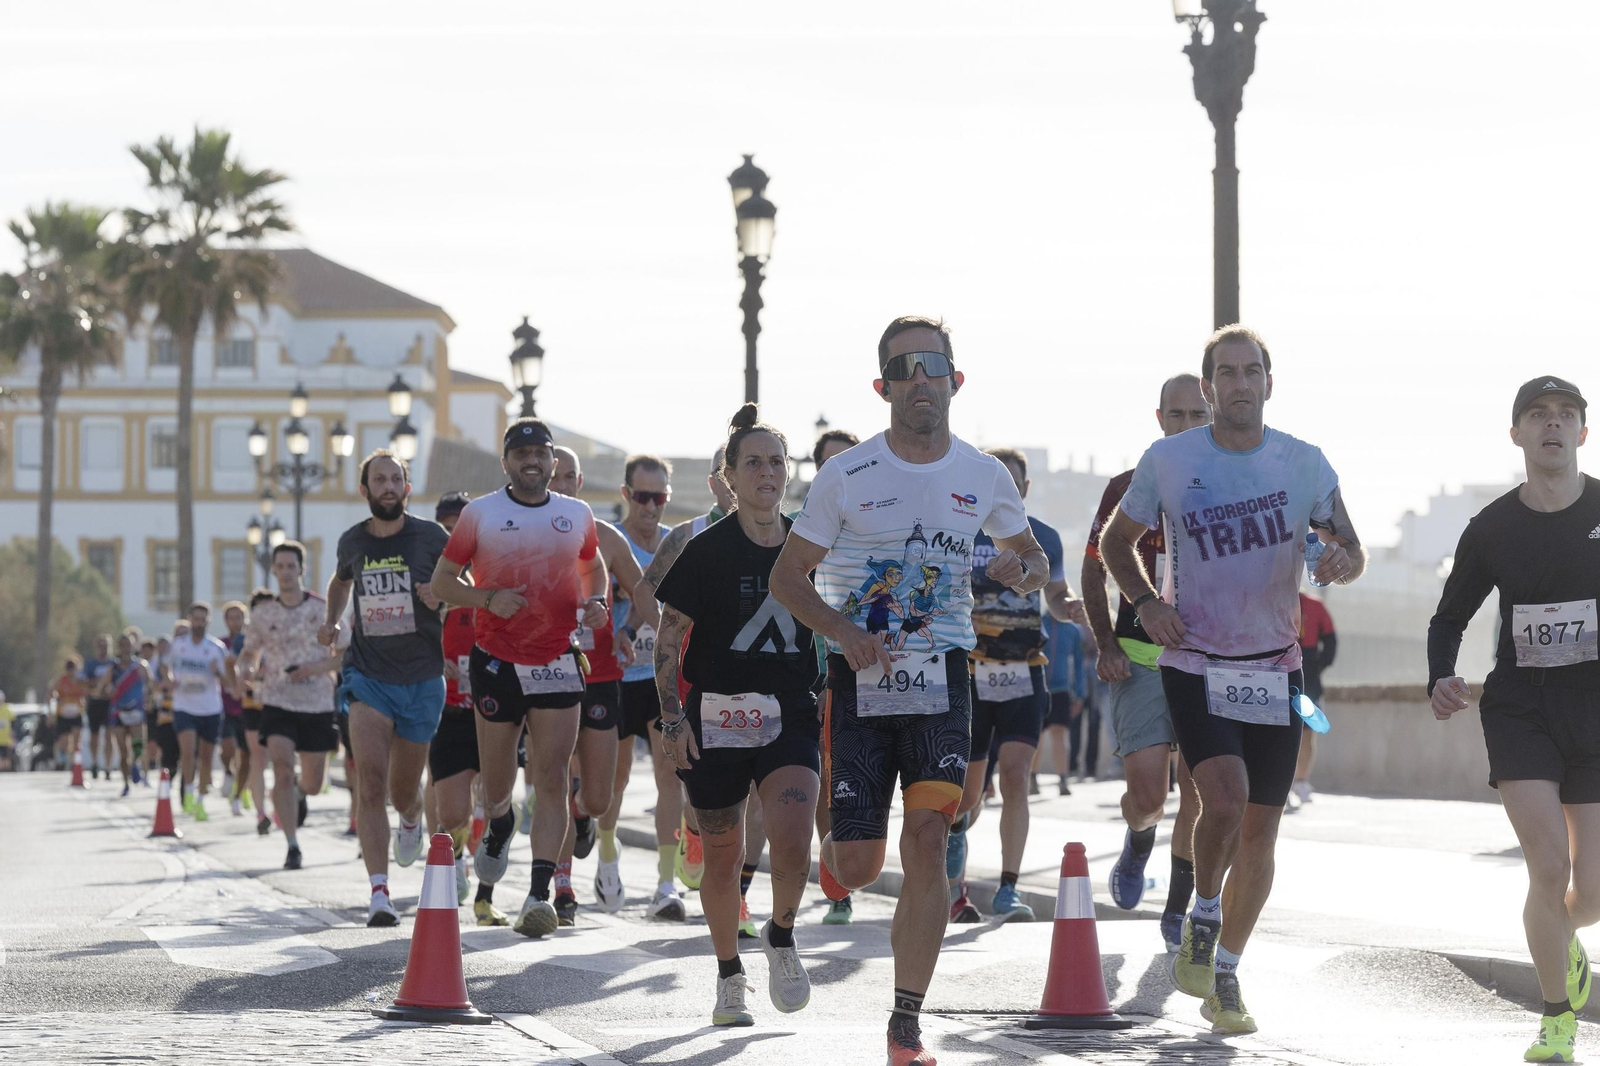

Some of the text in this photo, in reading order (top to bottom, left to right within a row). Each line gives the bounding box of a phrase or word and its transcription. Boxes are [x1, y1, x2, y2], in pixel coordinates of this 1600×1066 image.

[846, 462, 870, 476] luanvi
[1181, 490, 1289, 529] IX CORBONES
[1187, 507, 1294, 562] TRAIL
[361, 570, 412, 596] RUN
[366, 605, 405, 622] 2577
[1523, 619, 1585, 646] 1877
[531, 667, 565, 681] 626
[877, 669, 927, 693] 494
[988, 671, 1017, 687] 822
[1226, 685, 1270, 706] 823
[718, 708, 763, 729] 233
